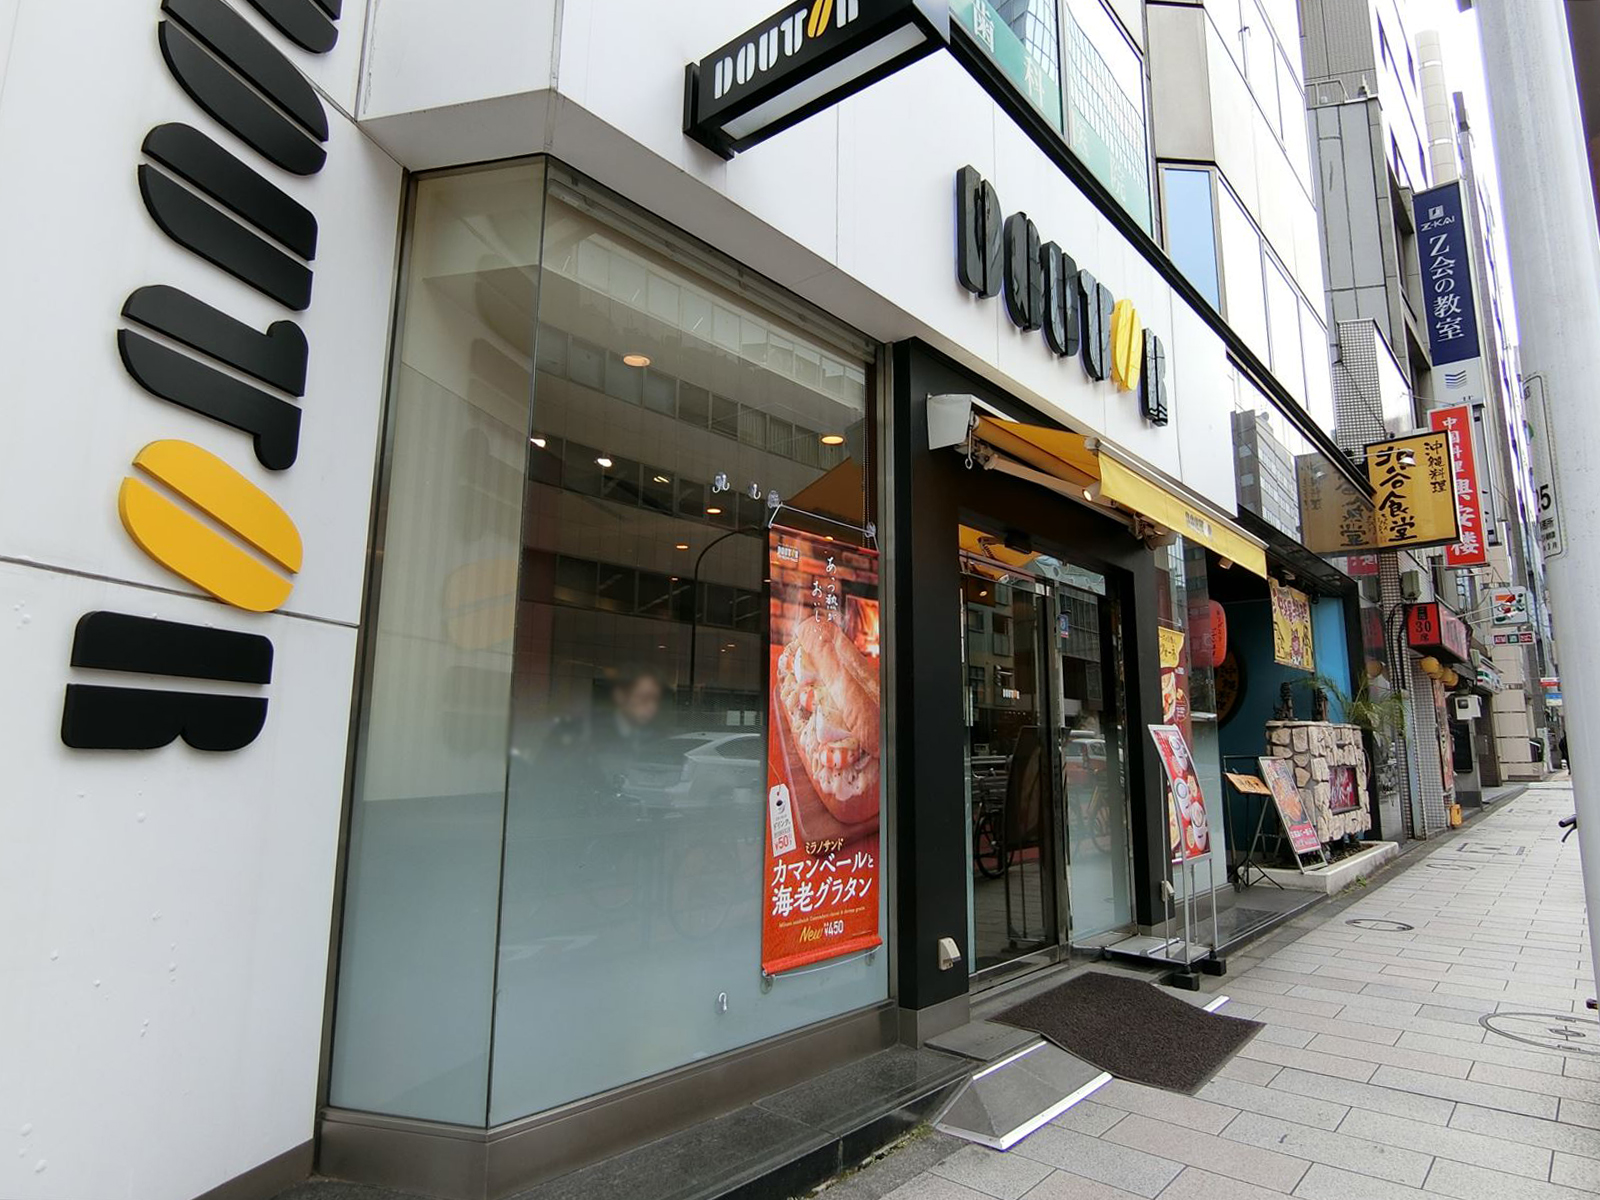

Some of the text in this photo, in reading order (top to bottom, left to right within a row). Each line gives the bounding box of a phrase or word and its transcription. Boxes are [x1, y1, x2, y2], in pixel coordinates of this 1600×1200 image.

[956, 164, 1168, 427] DOUTOR
[1428, 233, 1465, 342] Z会の教室
[61, 0, 342, 752] OUTOR
[804, 837, 844, 855] ミラノサンド
[771, 850, 874, 887] カマンベールと
[771, 876, 873, 918] 海老グラタン
[799, 925, 824, 943] New
